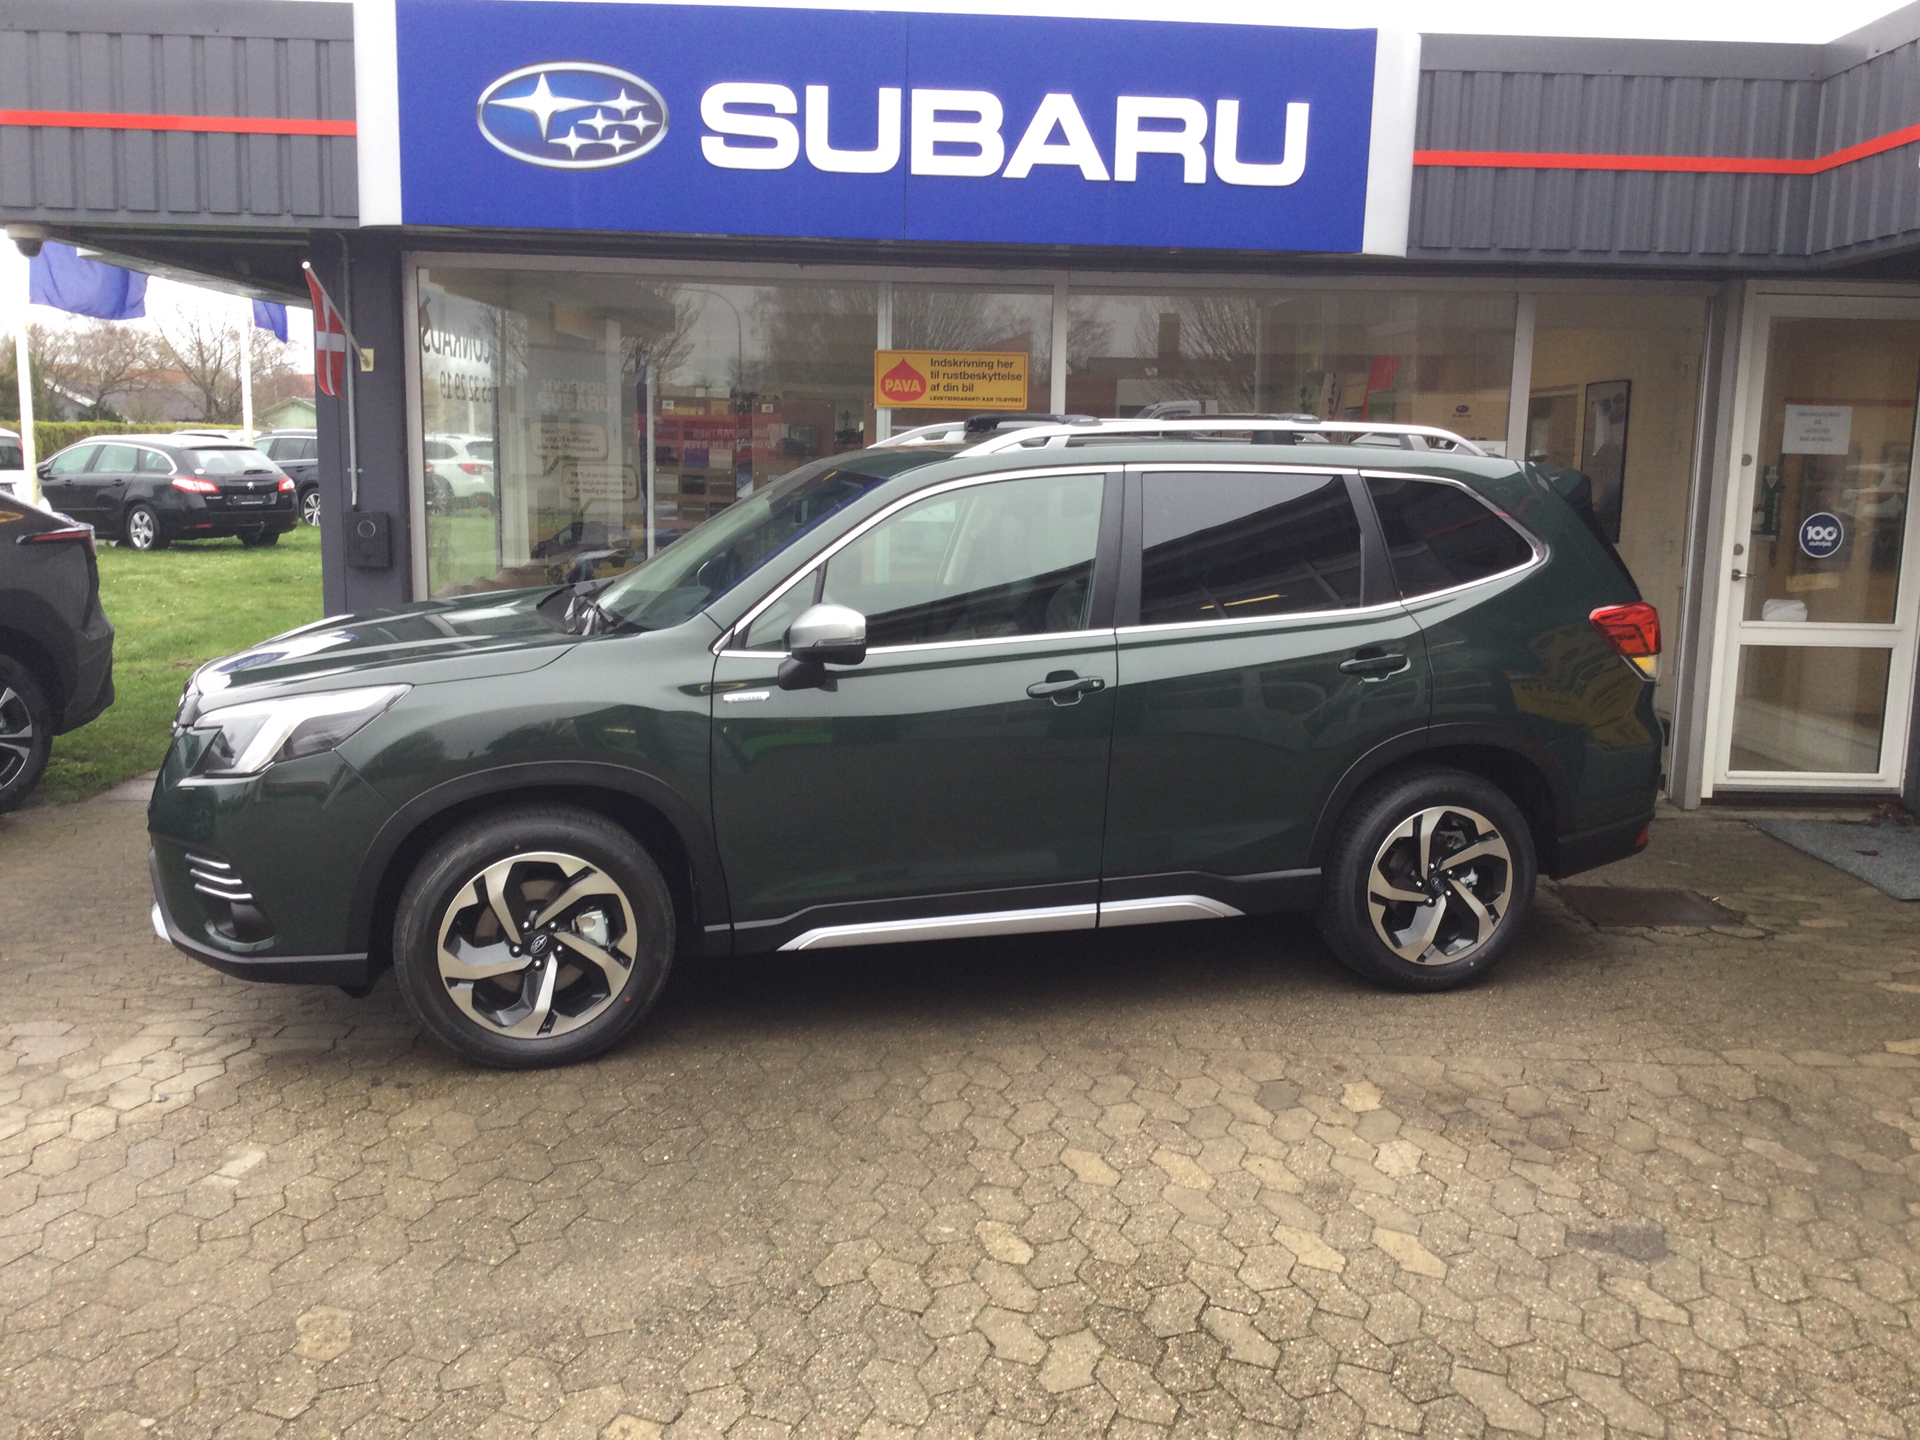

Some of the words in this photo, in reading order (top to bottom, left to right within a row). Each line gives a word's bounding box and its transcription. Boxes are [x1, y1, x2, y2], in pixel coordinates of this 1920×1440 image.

[700, 81, 1310, 187] SUBARU
[930, 358, 994, 370] Indskrivning
[997, 359, 1014, 369] her
[930, 370, 940, 380] til
[942, 371, 1022, 382] rustbeskyttelse
[885, 379, 921, 393] PAVA
[930, 382, 940, 392] af
[943, 383, 959, 392] din
[962, 383, 974, 393] bil
